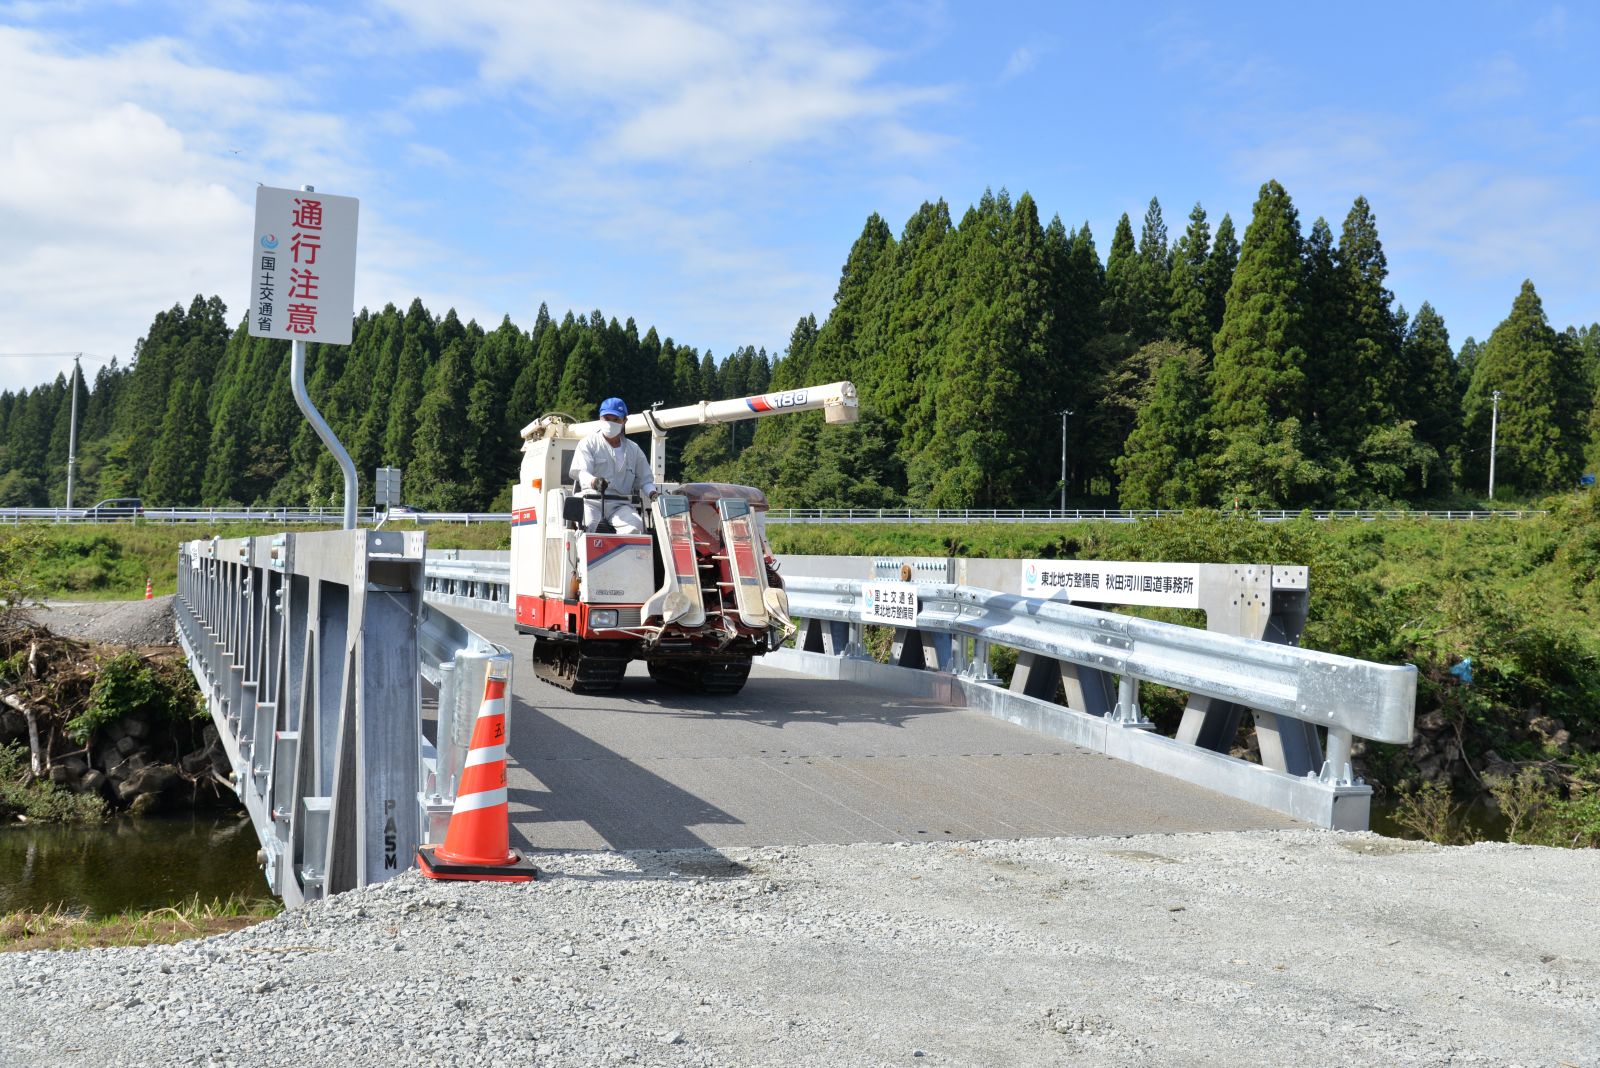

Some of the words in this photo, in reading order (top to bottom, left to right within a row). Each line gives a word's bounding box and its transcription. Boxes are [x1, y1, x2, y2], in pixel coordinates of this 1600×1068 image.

[286, 198, 322, 334] 通行注意
[257, 256, 275, 331] 国土交通省
[774, 390, 808, 408] 180
[1041, 571, 1100, 590] 東北地方整備局
[1105, 573, 1194, 594] 秋田河川国道事務所
[874, 589, 914, 605] 国土交通省
[874, 604, 914, 620] 東北地方整備局
